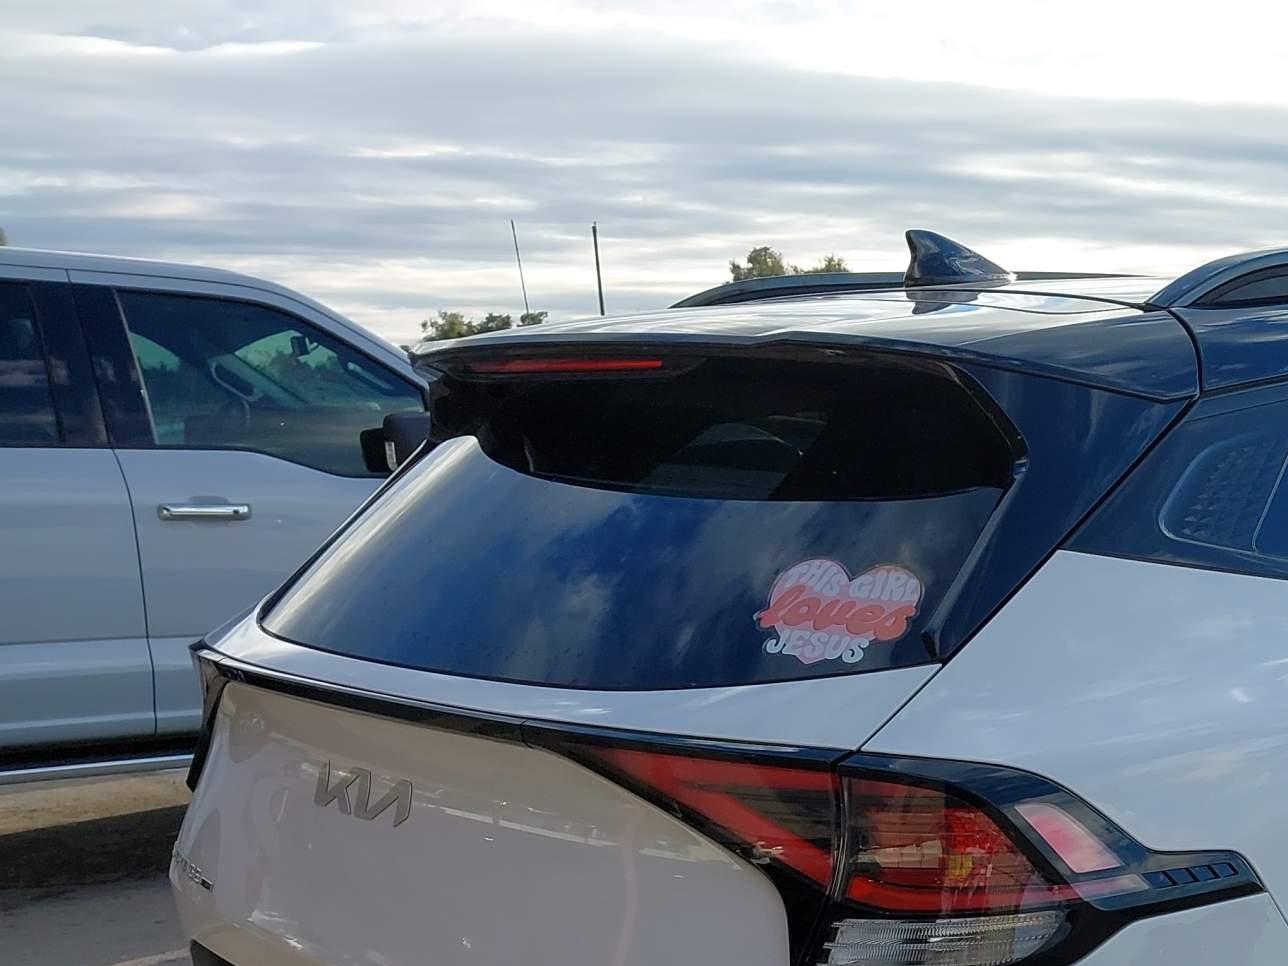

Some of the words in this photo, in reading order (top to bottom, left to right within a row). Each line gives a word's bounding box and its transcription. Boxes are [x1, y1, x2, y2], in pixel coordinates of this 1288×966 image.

[783, 560, 844, 598] THIS
[848, 571, 920, 602] GIRL
[765, 629, 870, 664] JESUS
[313, 759, 413, 828] KIA
